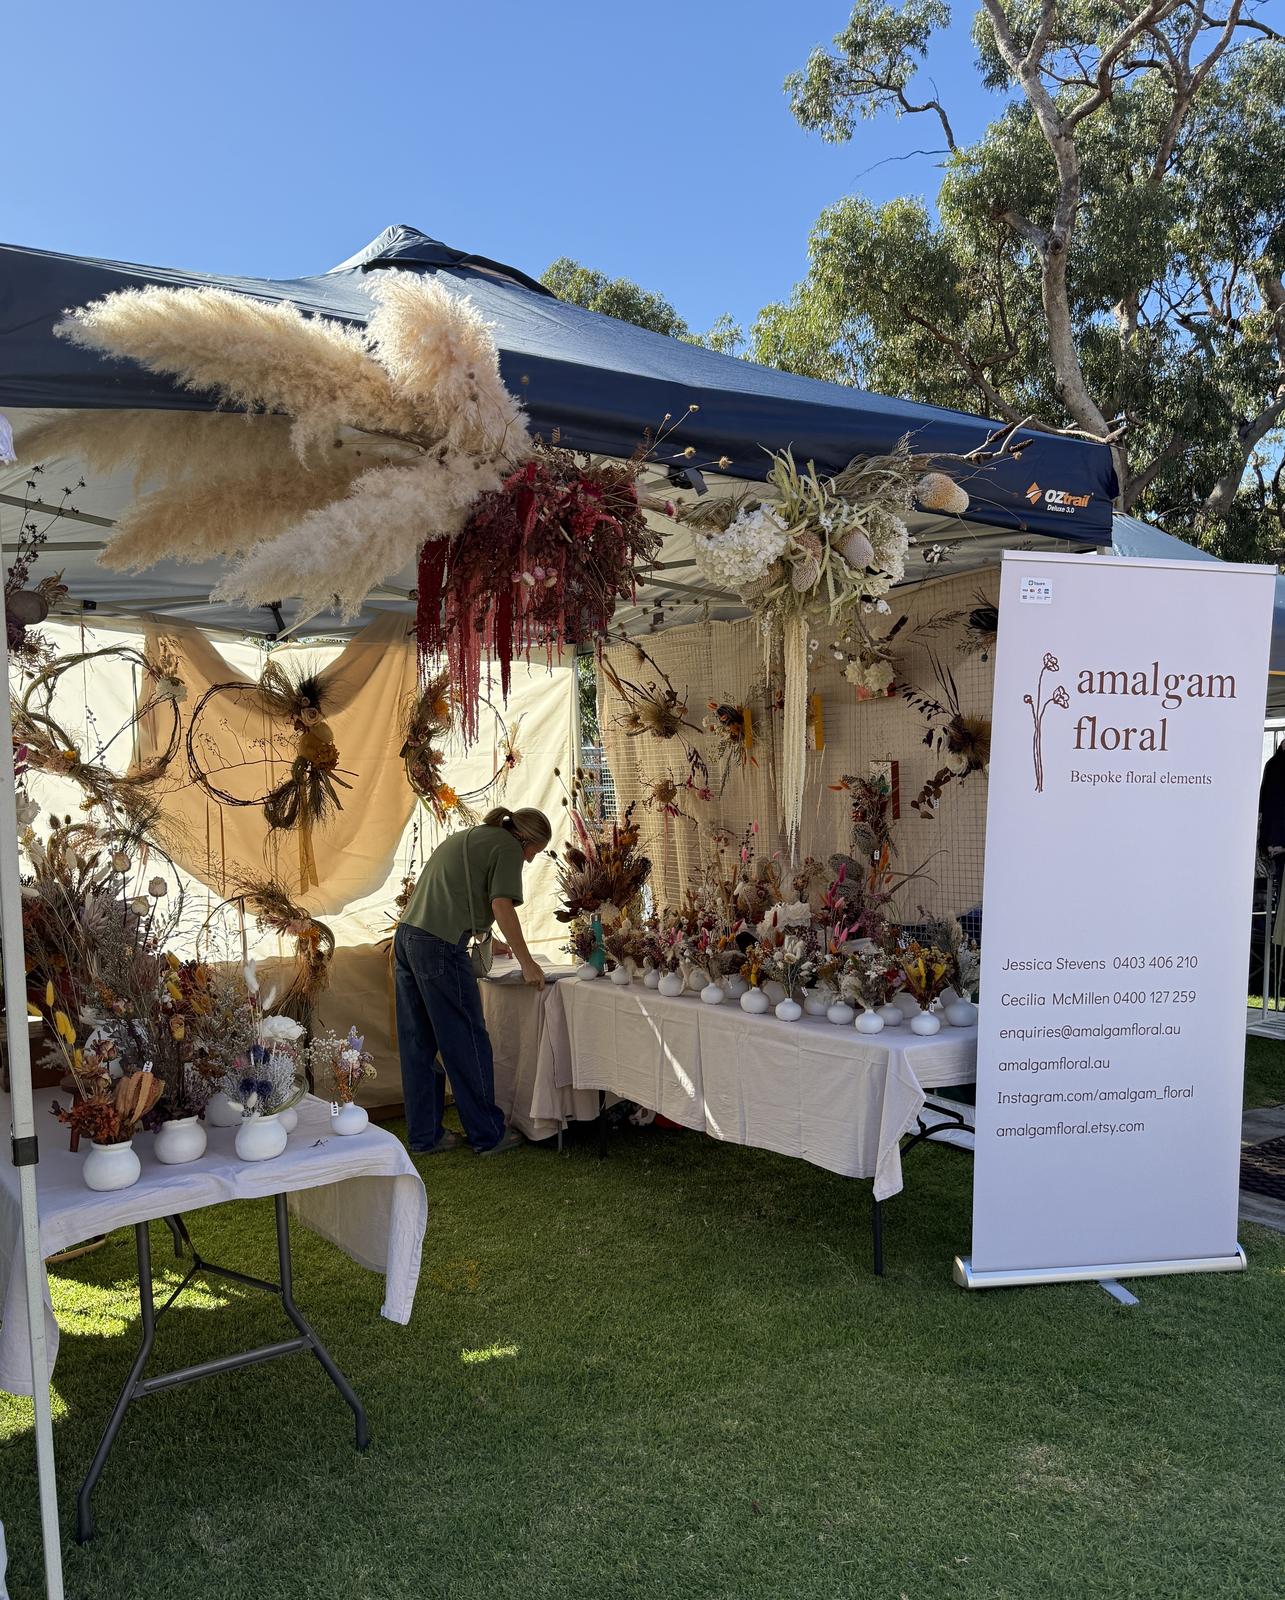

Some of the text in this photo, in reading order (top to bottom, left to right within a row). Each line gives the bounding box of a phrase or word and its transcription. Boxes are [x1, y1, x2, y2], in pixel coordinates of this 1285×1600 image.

[1044, 489, 1090, 508] OZtrail
[1047, 504, 1075, 514] Deluxe 3.0
[1077, 661, 1238, 711] amalgam
[1072, 715, 1169, 752] floral
[1070, 770, 1212, 786] Bespoke floral elements
[1002, 955, 1198, 971] Jessica Stevens 0403 406 210
[1001, 990, 1197, 1007] Cecilia McMillen 0400 127 259
[999, 1023, 1181, 1041] enquiries@amalgamfloral.au
[998, 1056, 1110, 1074] amalgamfloral.au
[997, 1085, 1194, 1107] Instagram.com/amalgam_floral
[996, 1121, 1145, 1139] amalgamfloral.etsy.com
